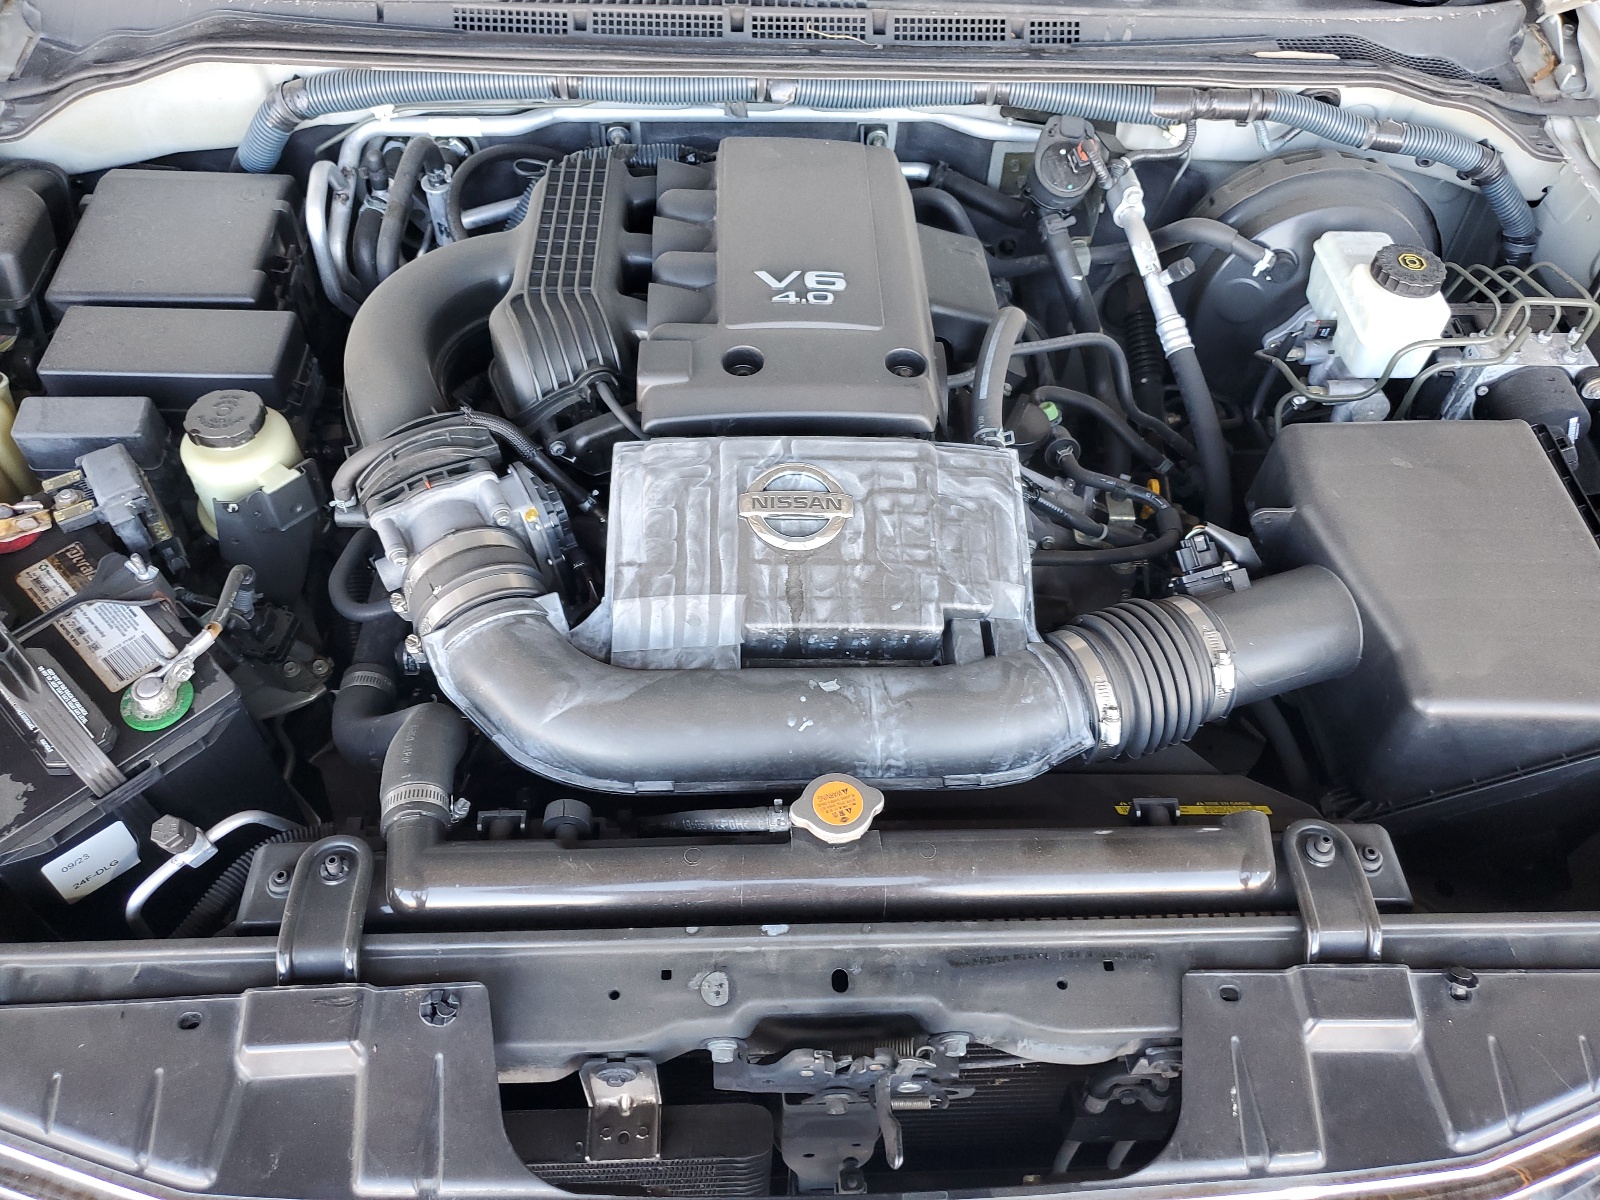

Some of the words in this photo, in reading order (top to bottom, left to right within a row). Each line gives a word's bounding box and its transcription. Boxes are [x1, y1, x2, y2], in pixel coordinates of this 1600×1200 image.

[753, 270, 847, 291] V6
[771, 291, 834, 304] 4.0
[751, 496, 842, 510] NISSAN
[61, 853, 90, 873] 09/23
